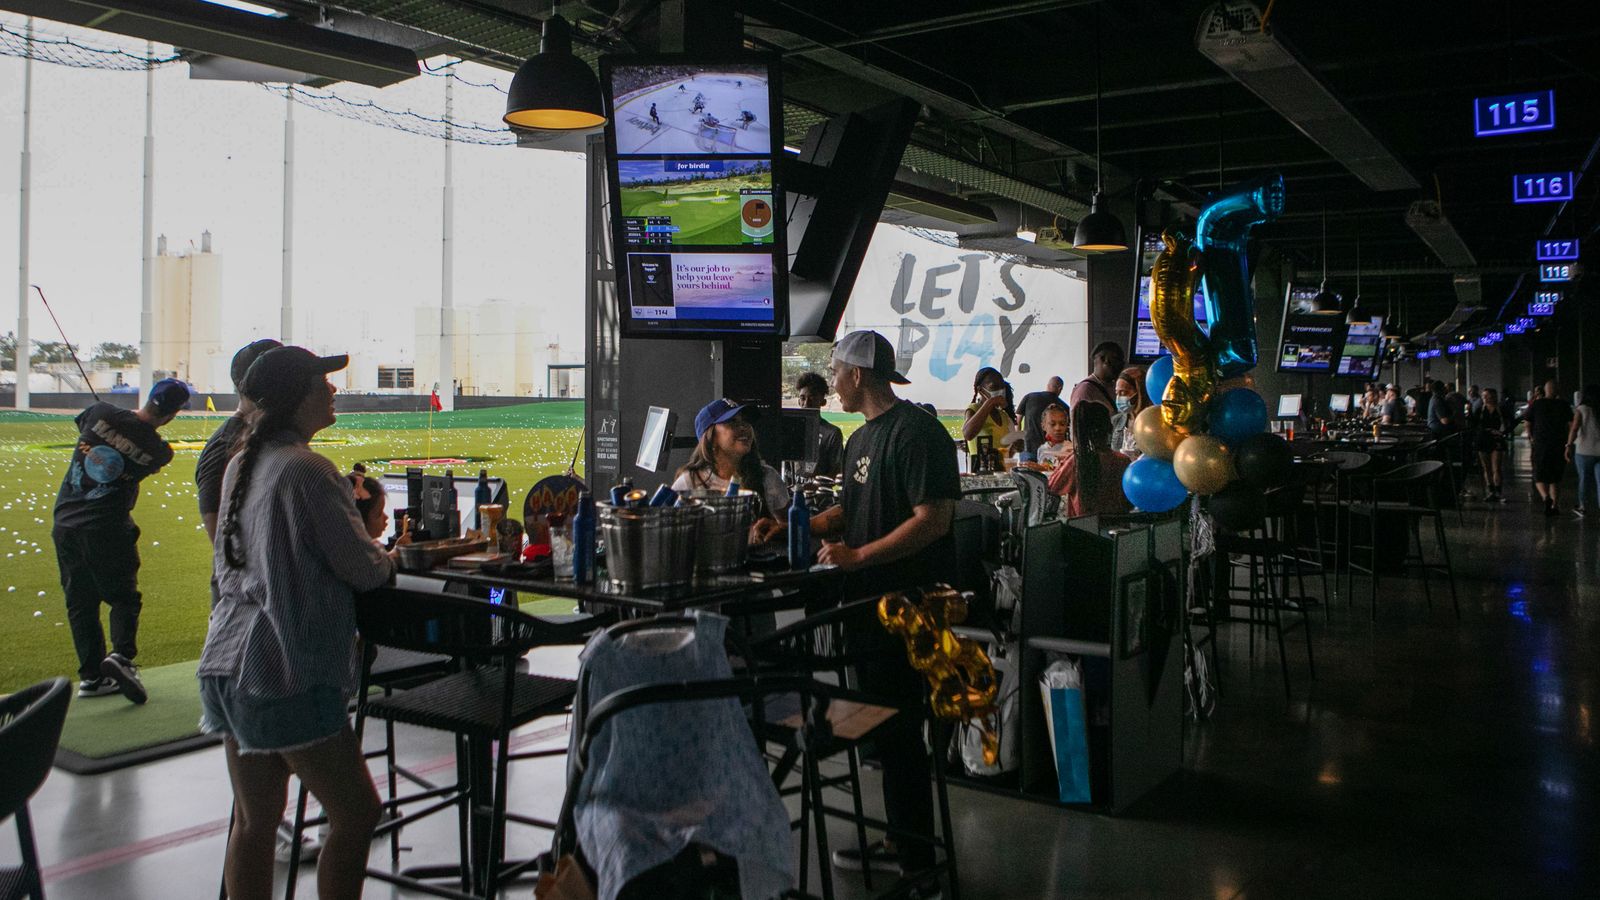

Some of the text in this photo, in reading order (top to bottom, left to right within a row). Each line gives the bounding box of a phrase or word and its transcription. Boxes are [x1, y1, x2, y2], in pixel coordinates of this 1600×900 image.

[1488, 98, 1540, 127] 115
[677, 162, 710, 171] for birdie
[1523, 176, 1563, 197] 116
[1544, 242, 1572, 256] 117
[676, 264, 689, 272] It's
[706, 265, 720, 274] job
[1546, 265, 1570, 278] 118
[676, 273, 695, 282] help
[713, 273, 734, 281] leave
[677, 283, 700, 291] yours
[890, 253, 1026, 320] LET'S
[1539, 292, 1559, 302] 119
[896, 313, 1034, 381] PLAY.
